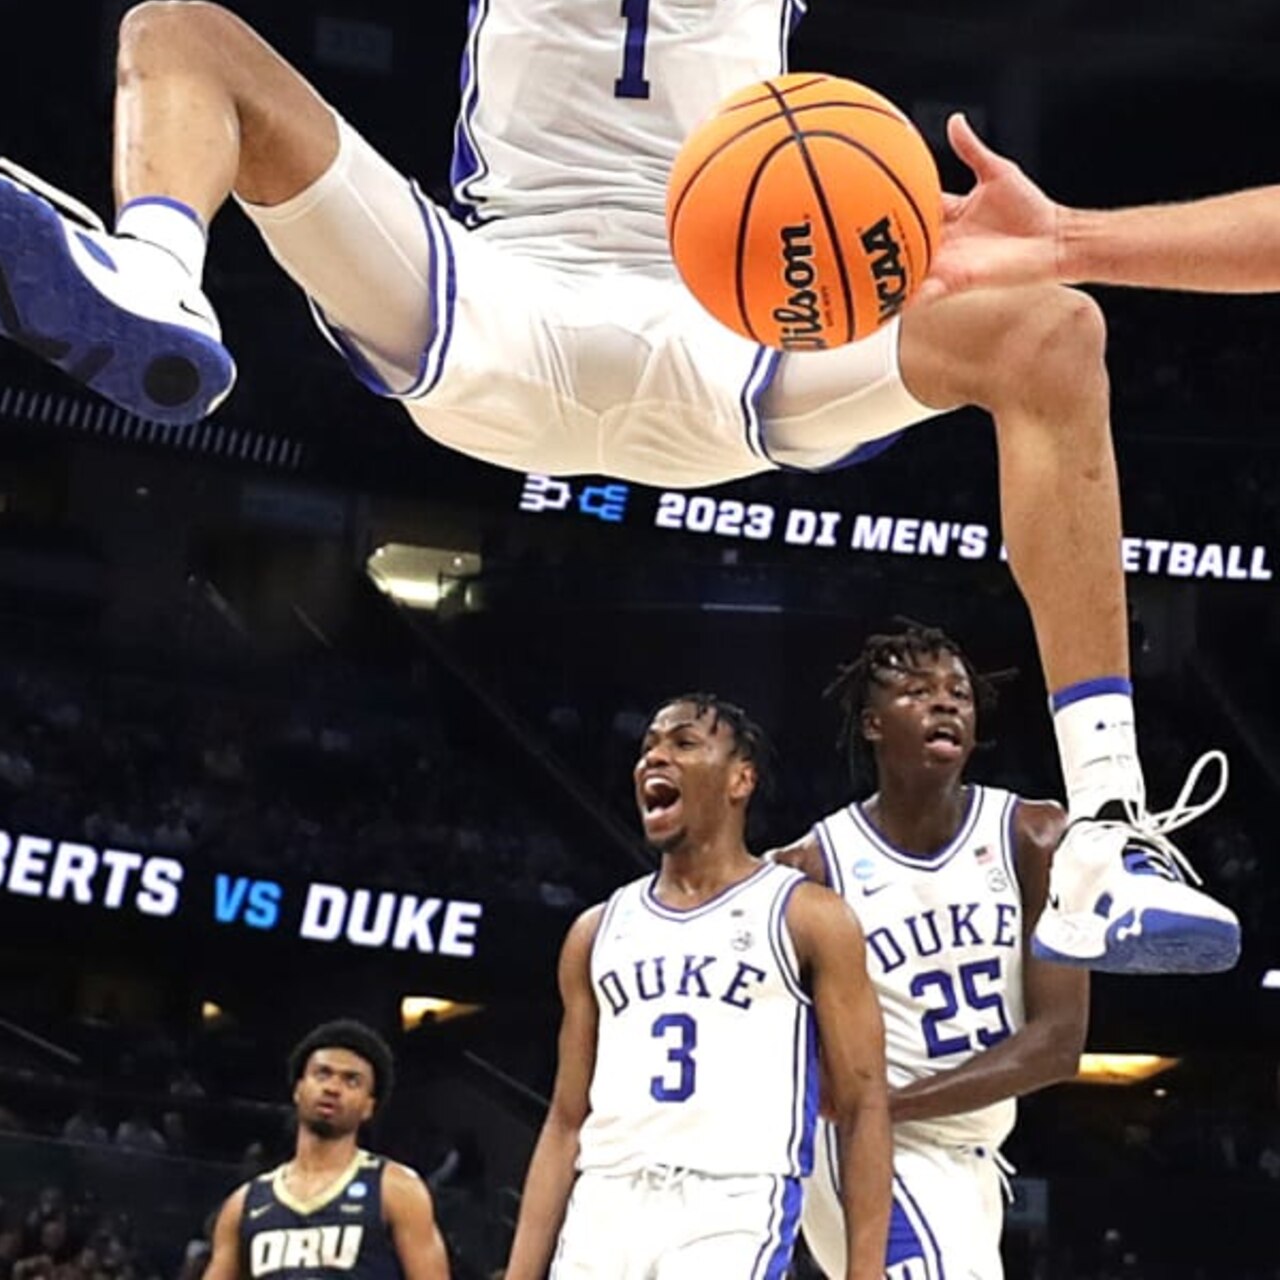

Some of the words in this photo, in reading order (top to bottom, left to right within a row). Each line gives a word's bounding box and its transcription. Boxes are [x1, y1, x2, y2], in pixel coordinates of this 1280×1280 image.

[655, 492, 774, 540] 2023
[784, 508, 841, 547] DI
[851, 515, 989, 559] MEN'S
[1001, 537, 1272, 581] ETBALL
[215, 874, 282, 929] VS
[299, 883, 483, 957] DUKE
[865, 903, 1017, 974] DUKE
[598, 955, 767, 1017] DUKE
[909, 957, 1011, 1059] 25
[649, 1012, 698, 1103] 3
[251, 1224, 364, 1278] ORU
